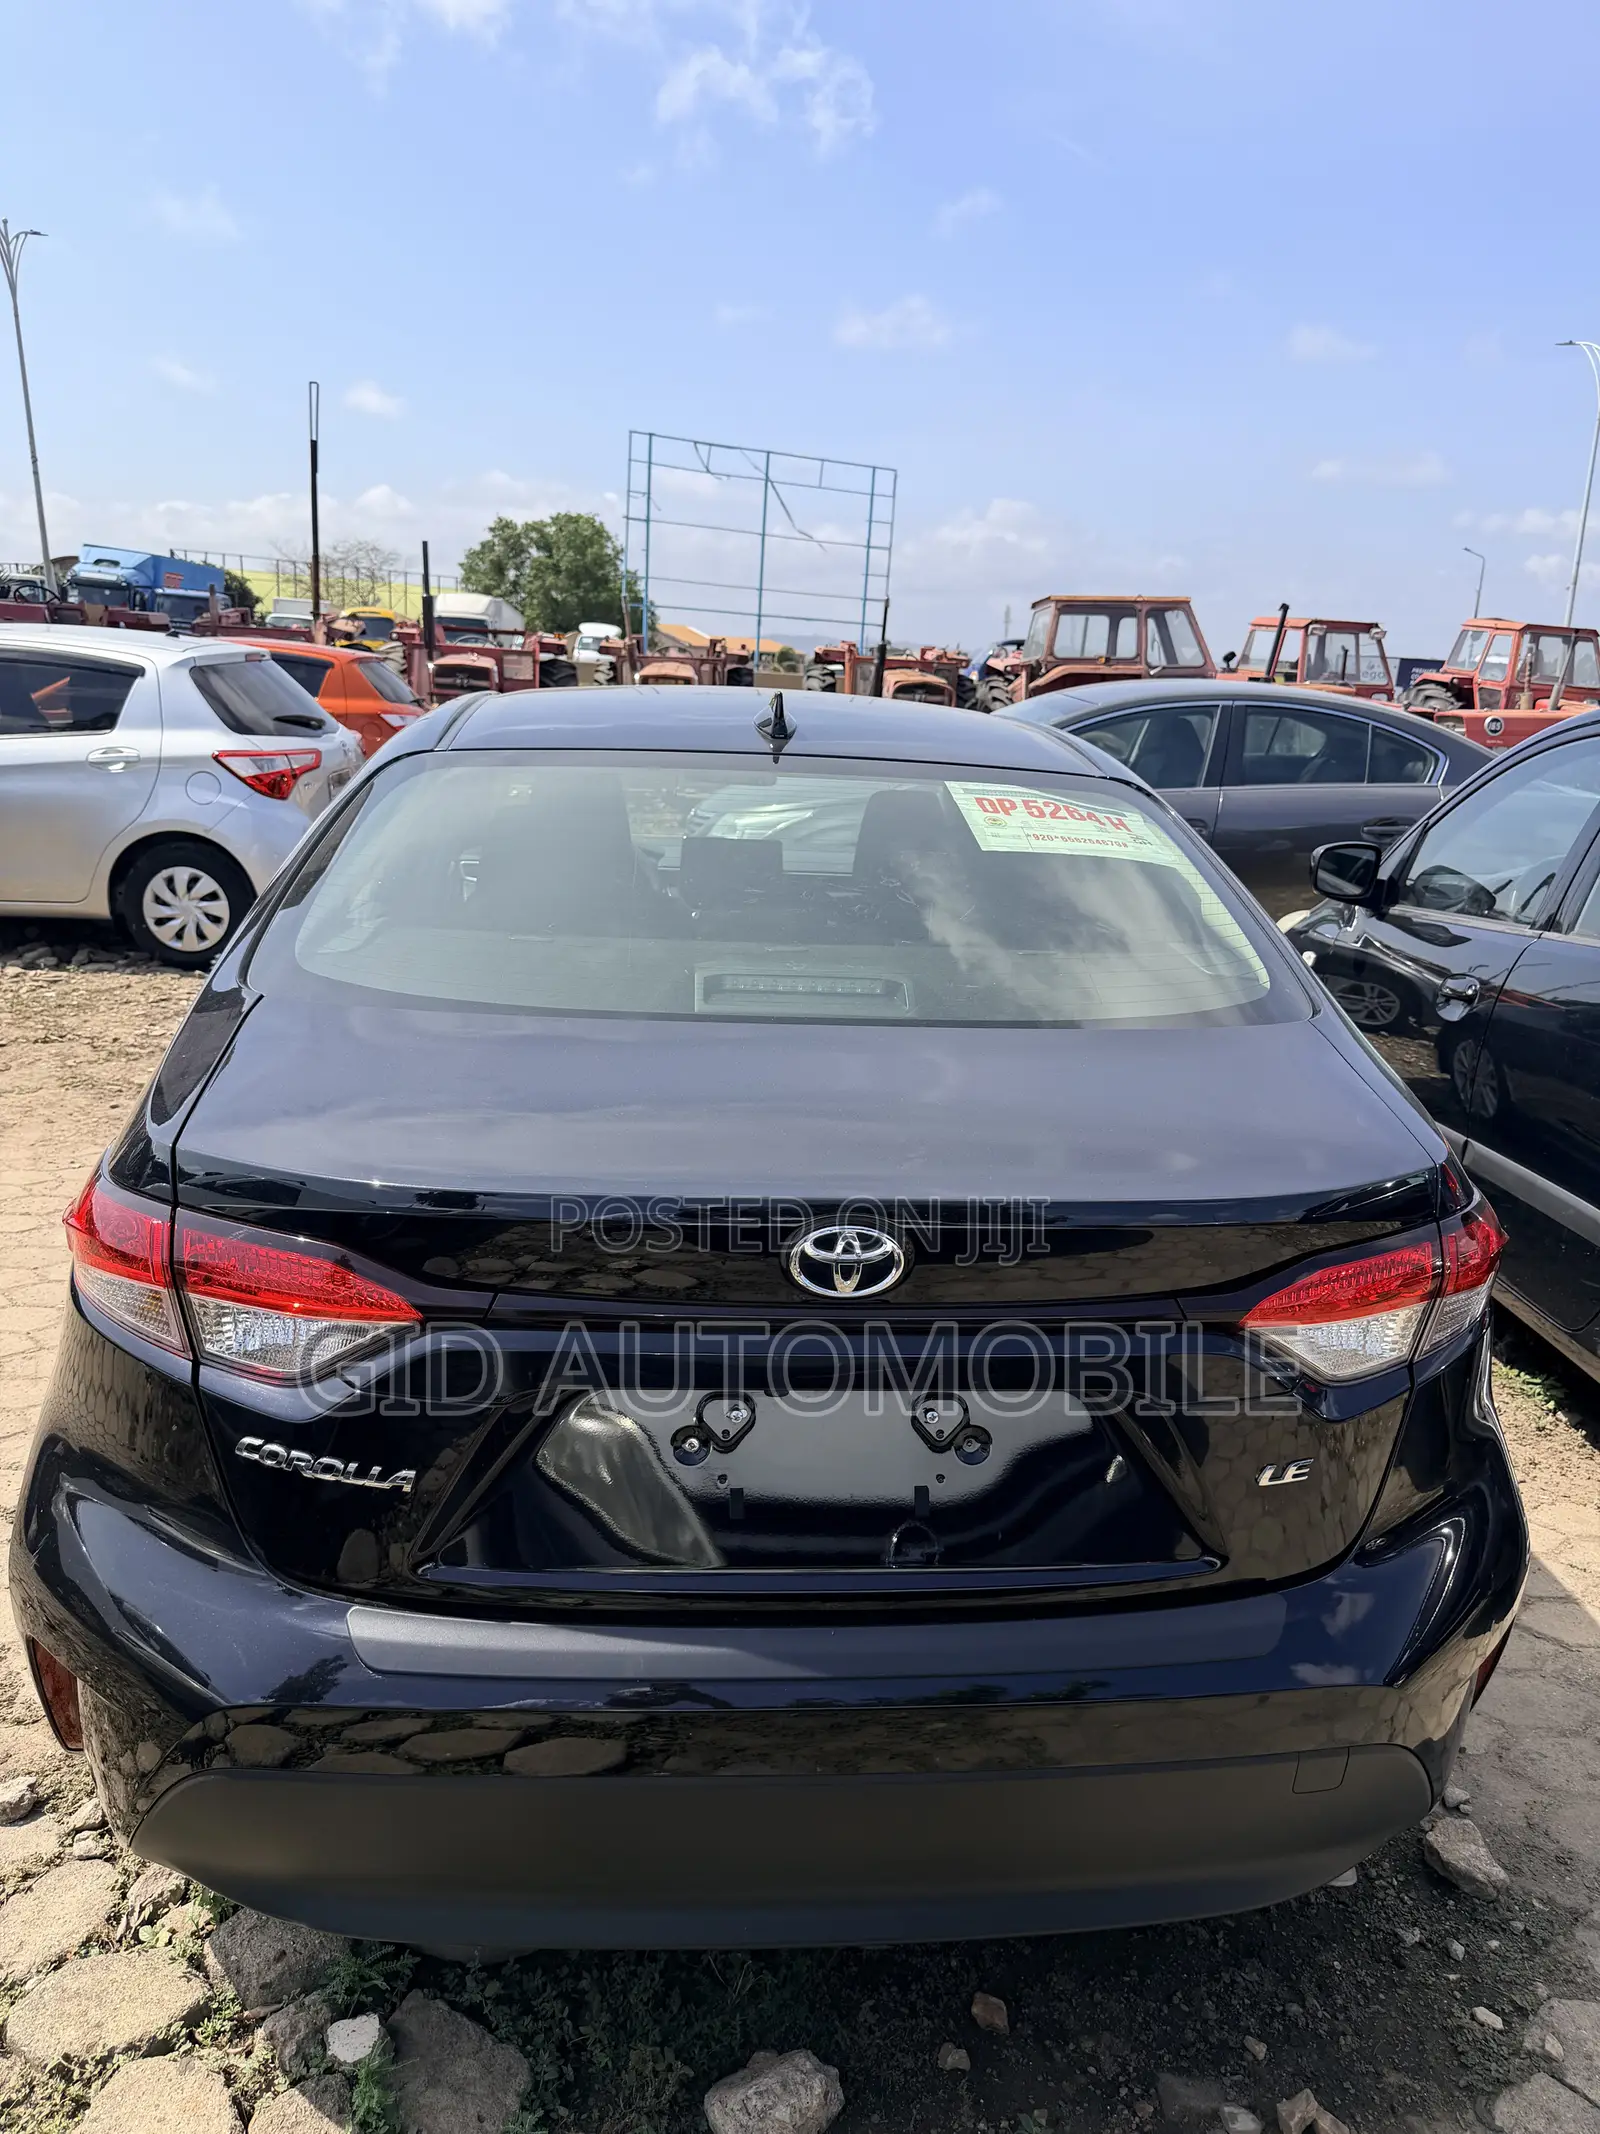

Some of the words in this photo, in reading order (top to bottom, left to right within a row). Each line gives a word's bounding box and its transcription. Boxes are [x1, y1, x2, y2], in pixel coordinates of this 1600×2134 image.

[975, 797, 1017, 816] DP
[1021, 799, 1106, 827] 5264
[1104, 815, 1132, 832] H
[235, 1436, 416, 1492] COROLLA
[1257, 1458, 1314, 1486] LE
